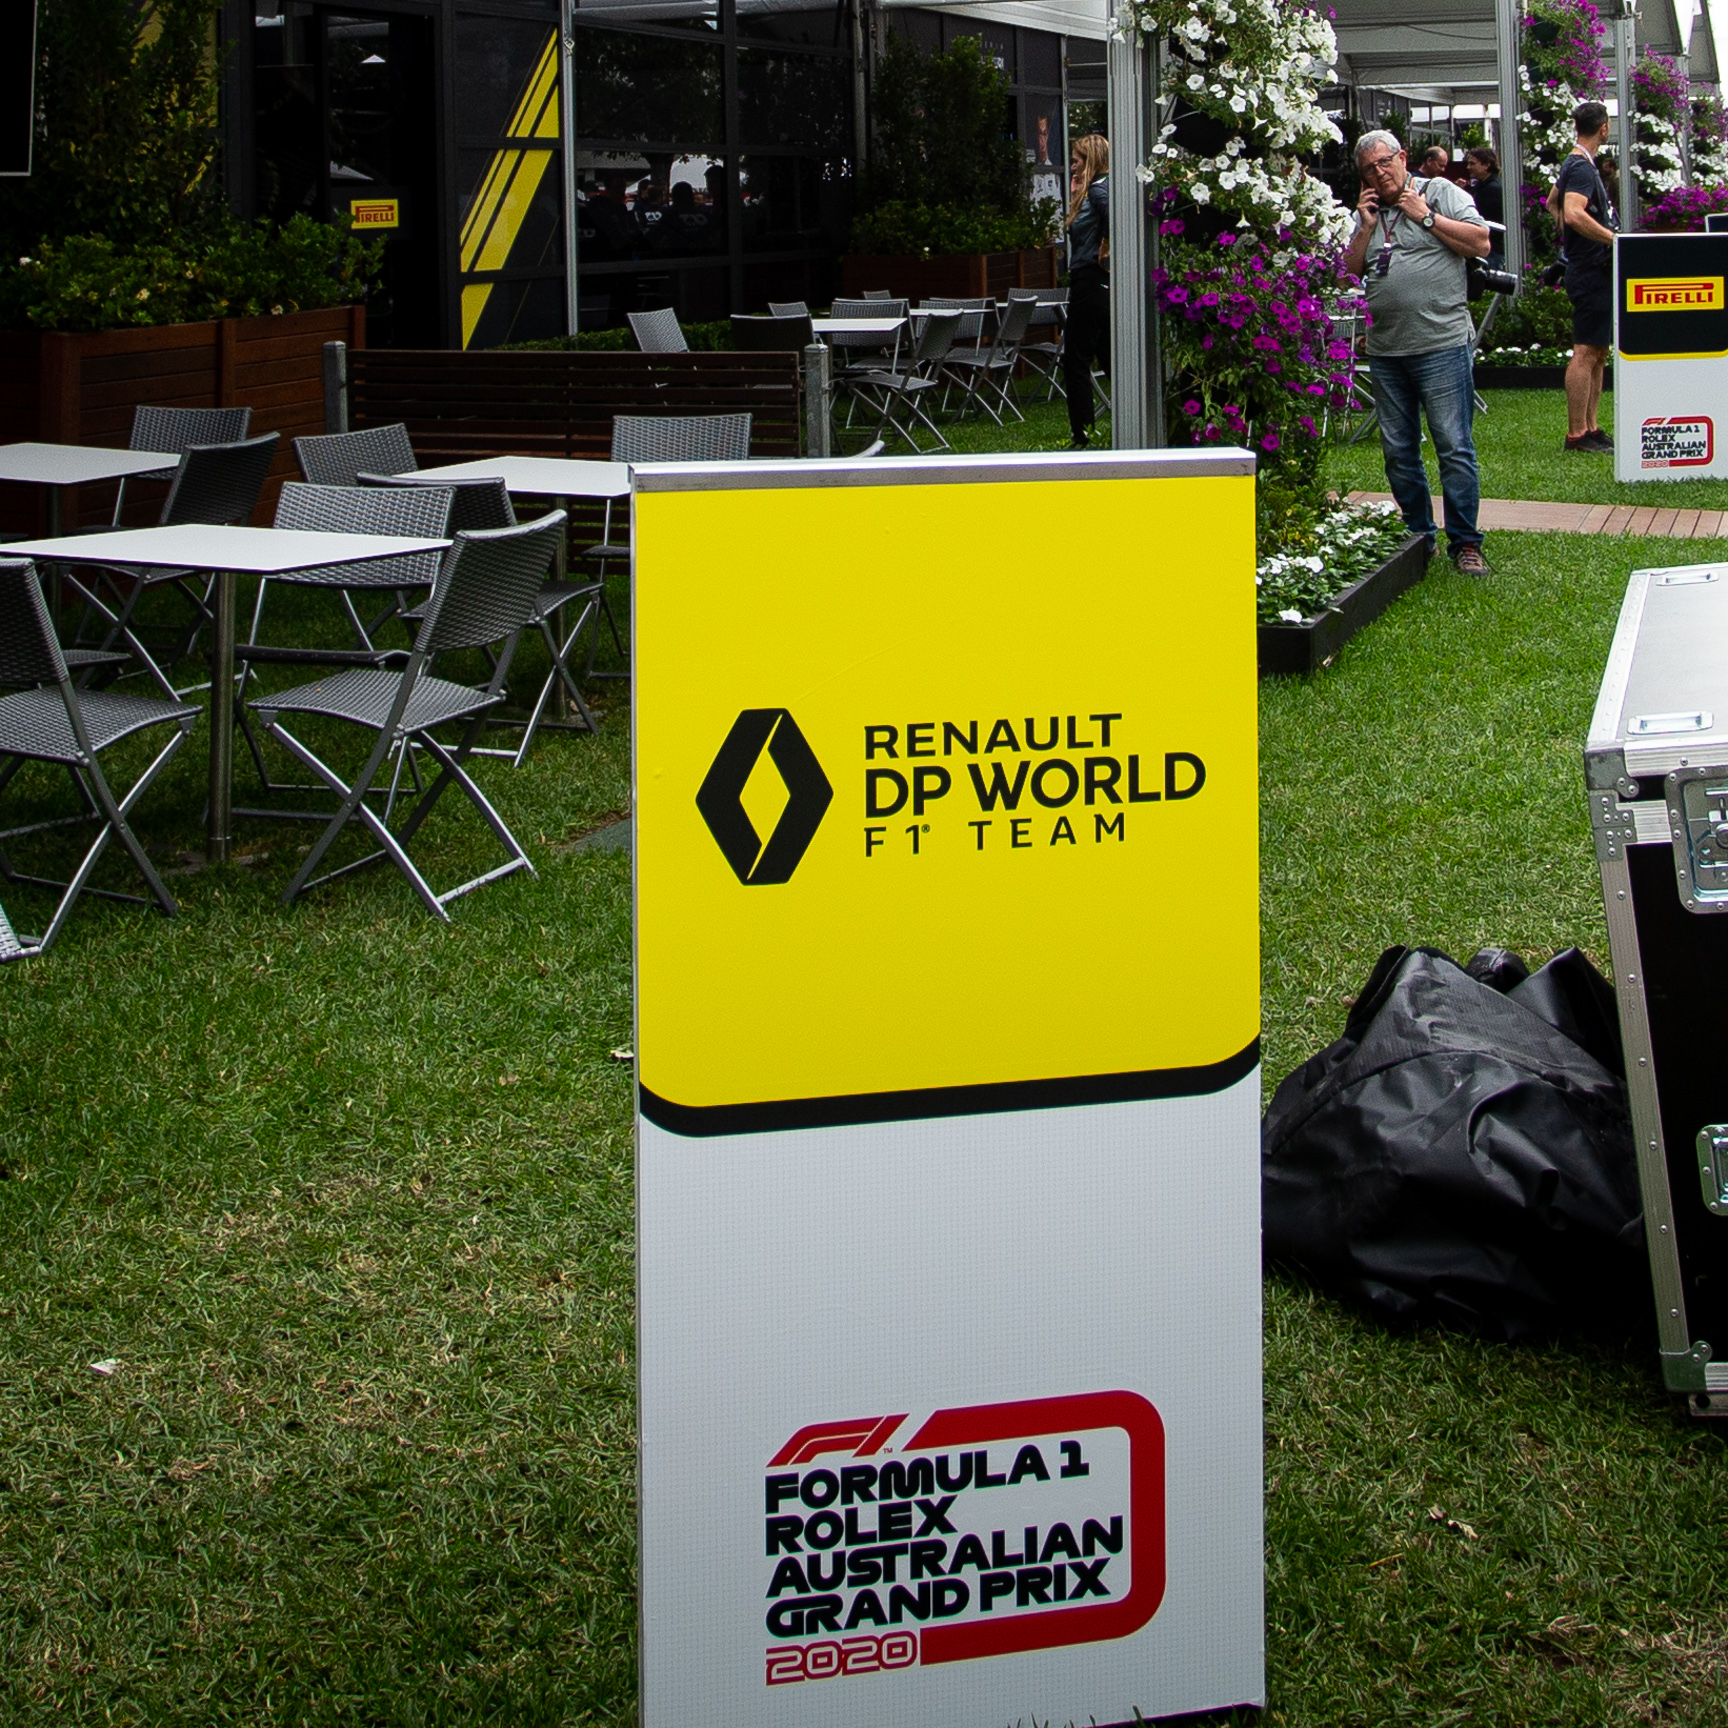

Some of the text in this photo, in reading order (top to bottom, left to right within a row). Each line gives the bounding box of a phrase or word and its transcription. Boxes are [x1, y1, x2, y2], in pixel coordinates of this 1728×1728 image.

[354, 204, 395, 224] PIRELLI
[1634, 283, 1715, 305] PIRELLI
[1641, 425, 1693, 435] FORMULA
[1641, 435, 1675, 443] ROLEX
[1641, 441, 1706, 451] AUSTRALIAN
[1641, 449, 1703, 459] GRAND PRIX
[1641, 459, 1669, 469] 2020
[864, 713, 1122, 760] RENAULT
[864, 751, 1207, 818] DP WORLD
[968, 812, 1127, 851] TEAM
[765, 1440, 1089, 1514] FORMULA 1
[765, 1494, 958, 1557] ROLEX
[765, 1515, 1124, 1599] AUSTRALIAN
[765, 1557, 1112, 1638] GRAND PRIX
[765, 1630, 919, 1687] 2020
